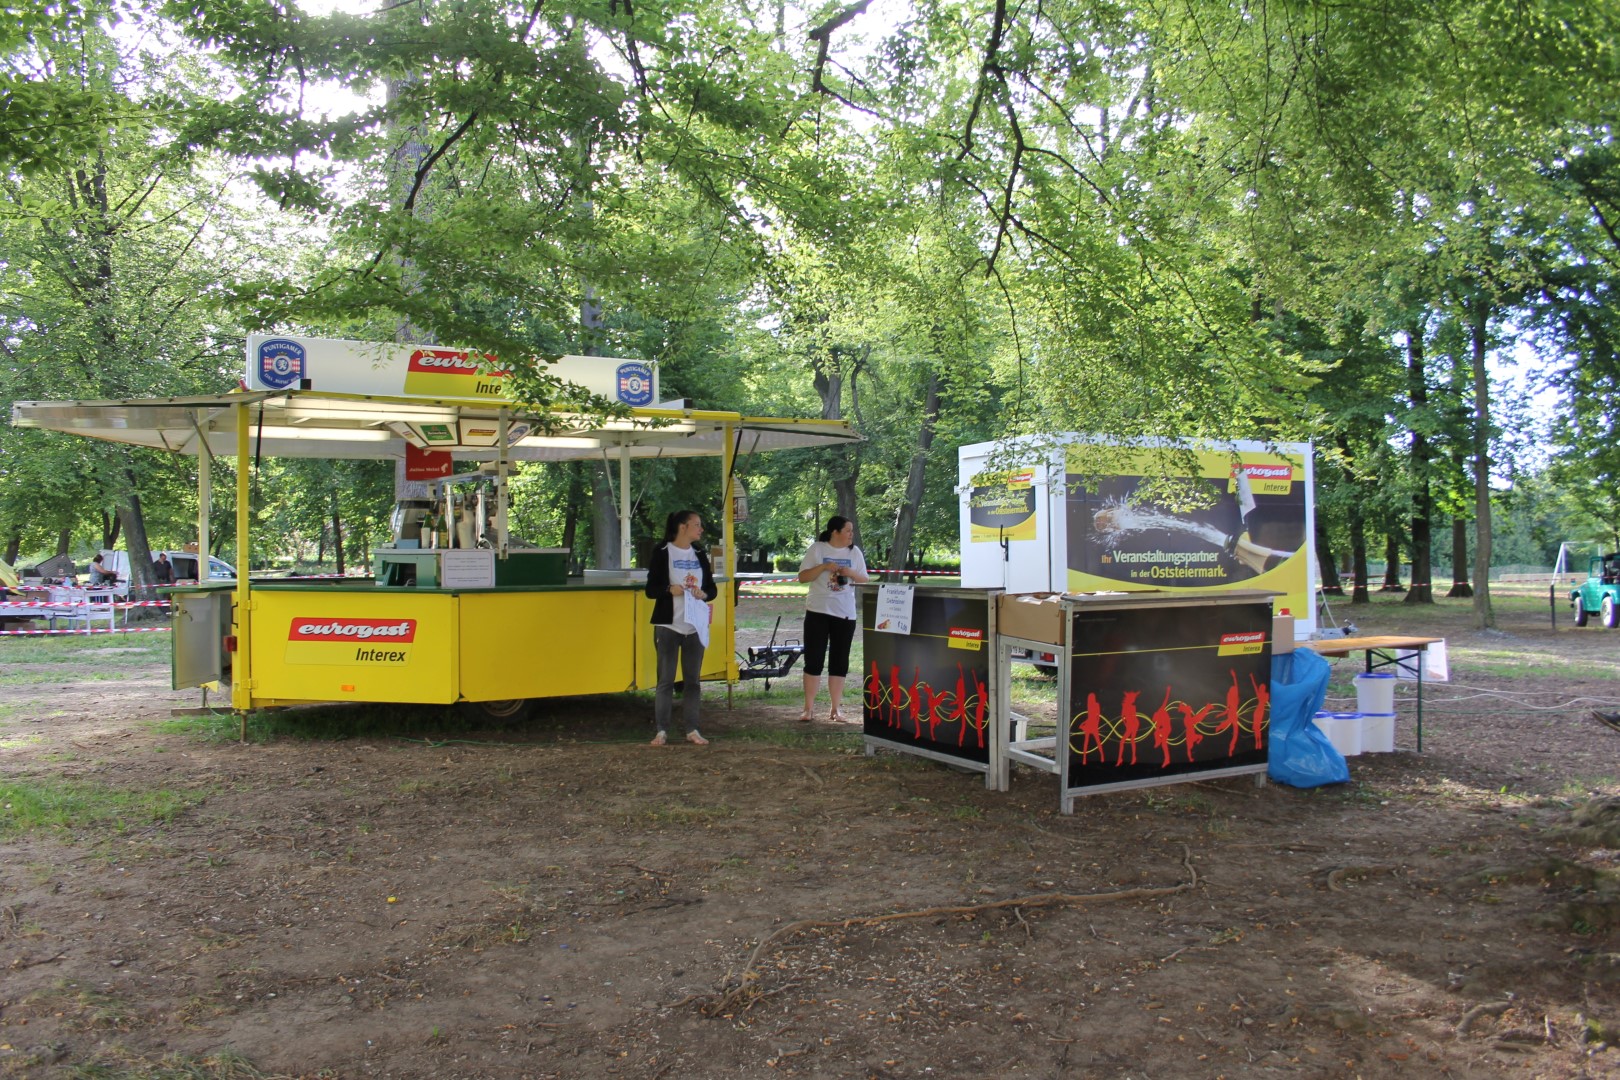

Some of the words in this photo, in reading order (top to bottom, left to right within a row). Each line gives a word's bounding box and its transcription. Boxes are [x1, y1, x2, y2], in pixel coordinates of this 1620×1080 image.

[263, 343, 302, 355] PUNTIGAMER
[475, 381, 502, 395] Inte
[1264, 483, 1288, 492] Interex
[1101, 554, 1112, 563] Ihr
[1113, 549, 1219, 565] Veranstaltungspartner
[1131, 569, 1137, 577] in
[1139, 569, 1150, 577] der
[1151, 565, 1227, 578] Oststeiermark.
[298, 622, 410, 638] eurogast
[951, 629, 980, 637] eurogast
[1223, 633, 1262, 642] eurogast
[355, 648, 406, 662] Interex
